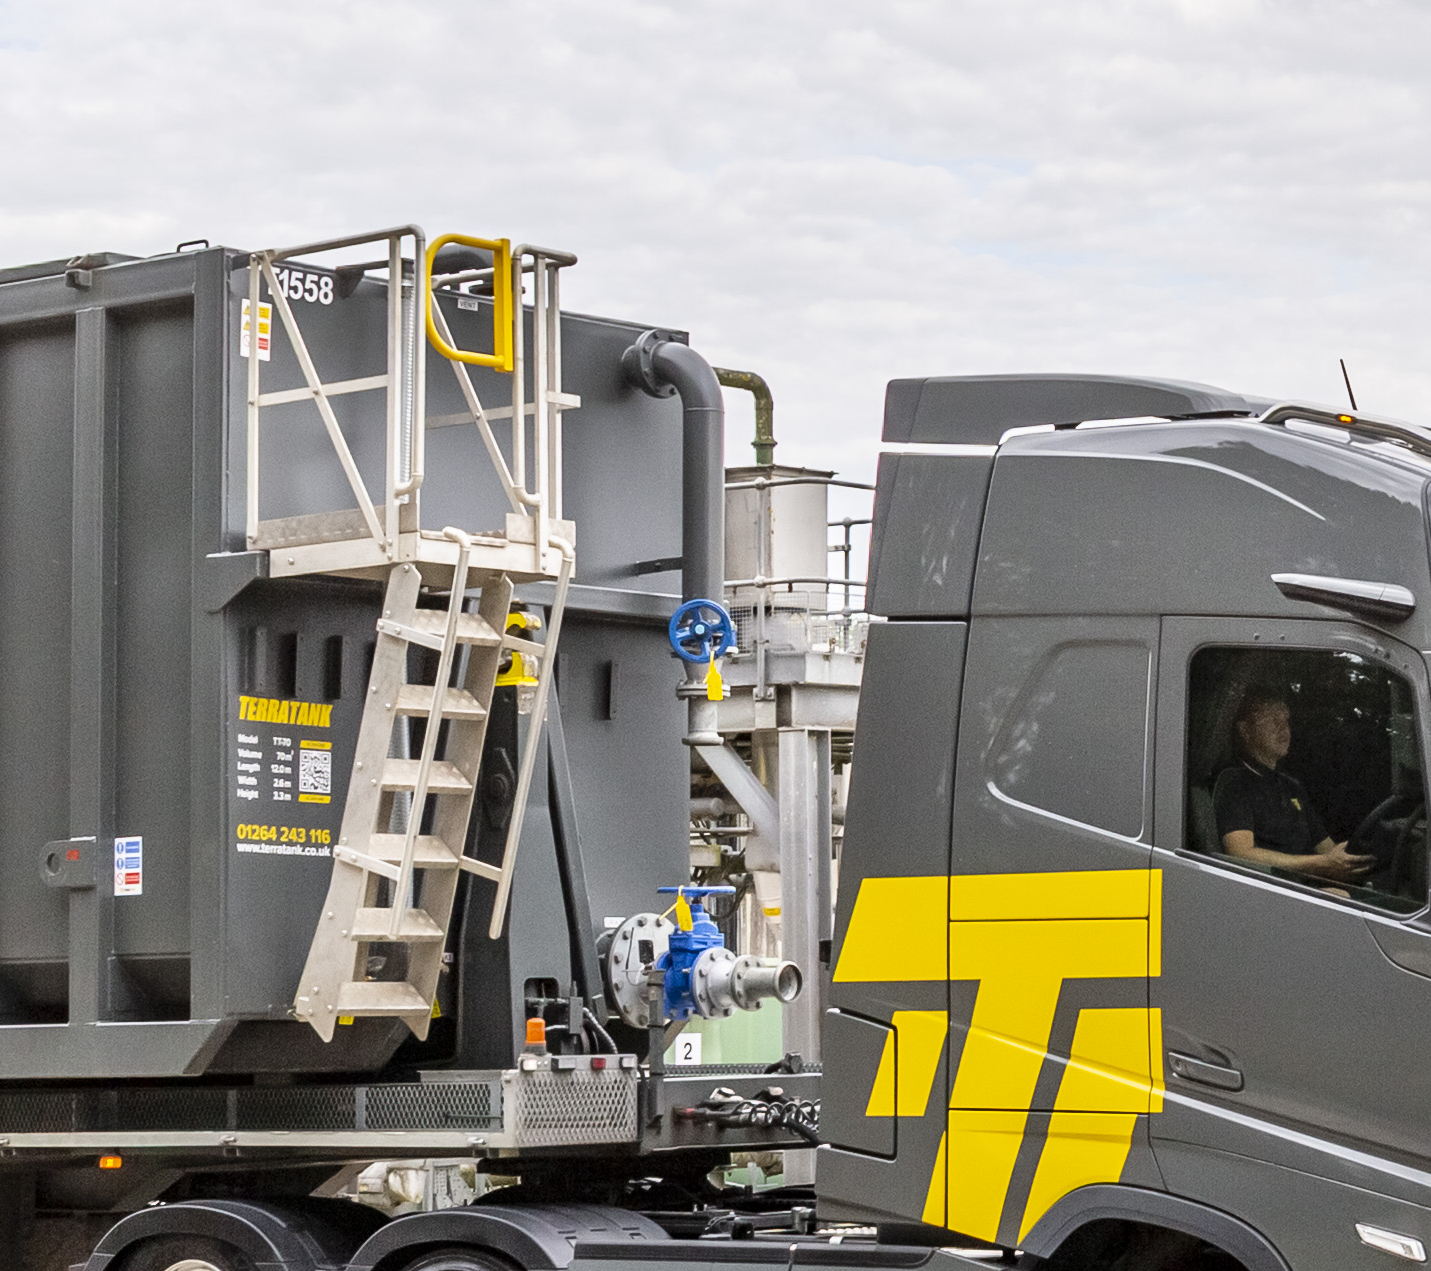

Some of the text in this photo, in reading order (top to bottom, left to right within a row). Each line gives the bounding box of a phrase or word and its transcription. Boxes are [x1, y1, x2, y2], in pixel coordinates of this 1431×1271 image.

[239, 695, 333, 727] TERRATANK
[237, 733, 259, 744] Model
[237, 748, 263, 759] Volume
[237, 761, 260, 773] Length
[237, 775, 258, 786] Width
[236, 788, 259, 801] Height
[236, 823, 331, 844] 01264 243 116
[236, 843, 331, 857] www.terratank.co.uk
[683, 1042, 693, 1060] 2
